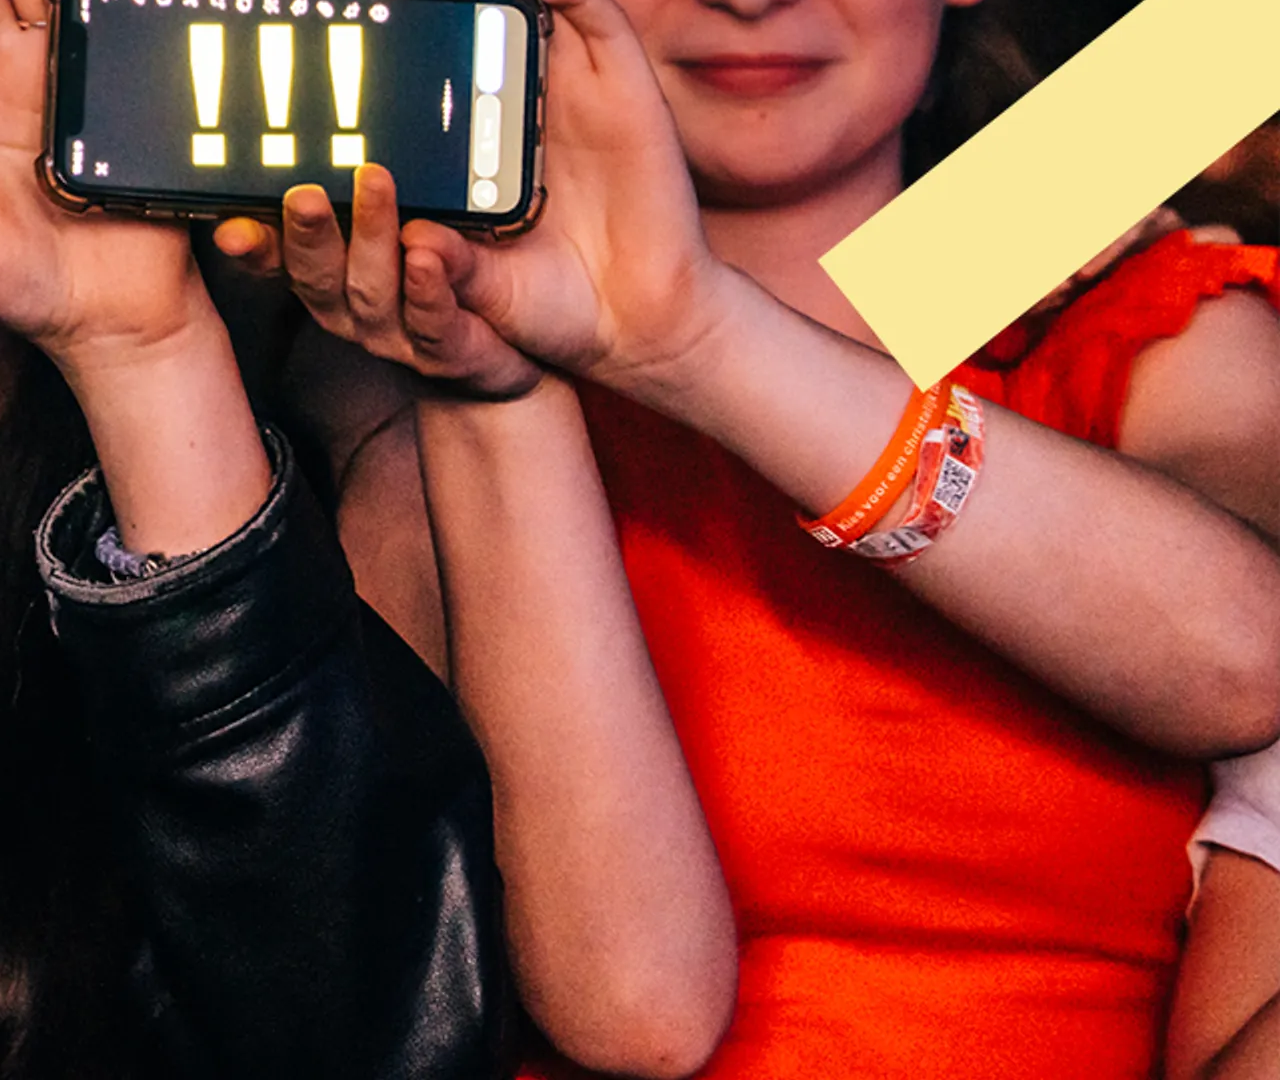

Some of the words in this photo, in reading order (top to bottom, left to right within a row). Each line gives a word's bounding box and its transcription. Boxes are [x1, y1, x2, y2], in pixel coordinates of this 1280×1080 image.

[188, 23, 366, 167] !!!
[862, 481, 889, 510] voor
[887, 456, 909, 482] een
